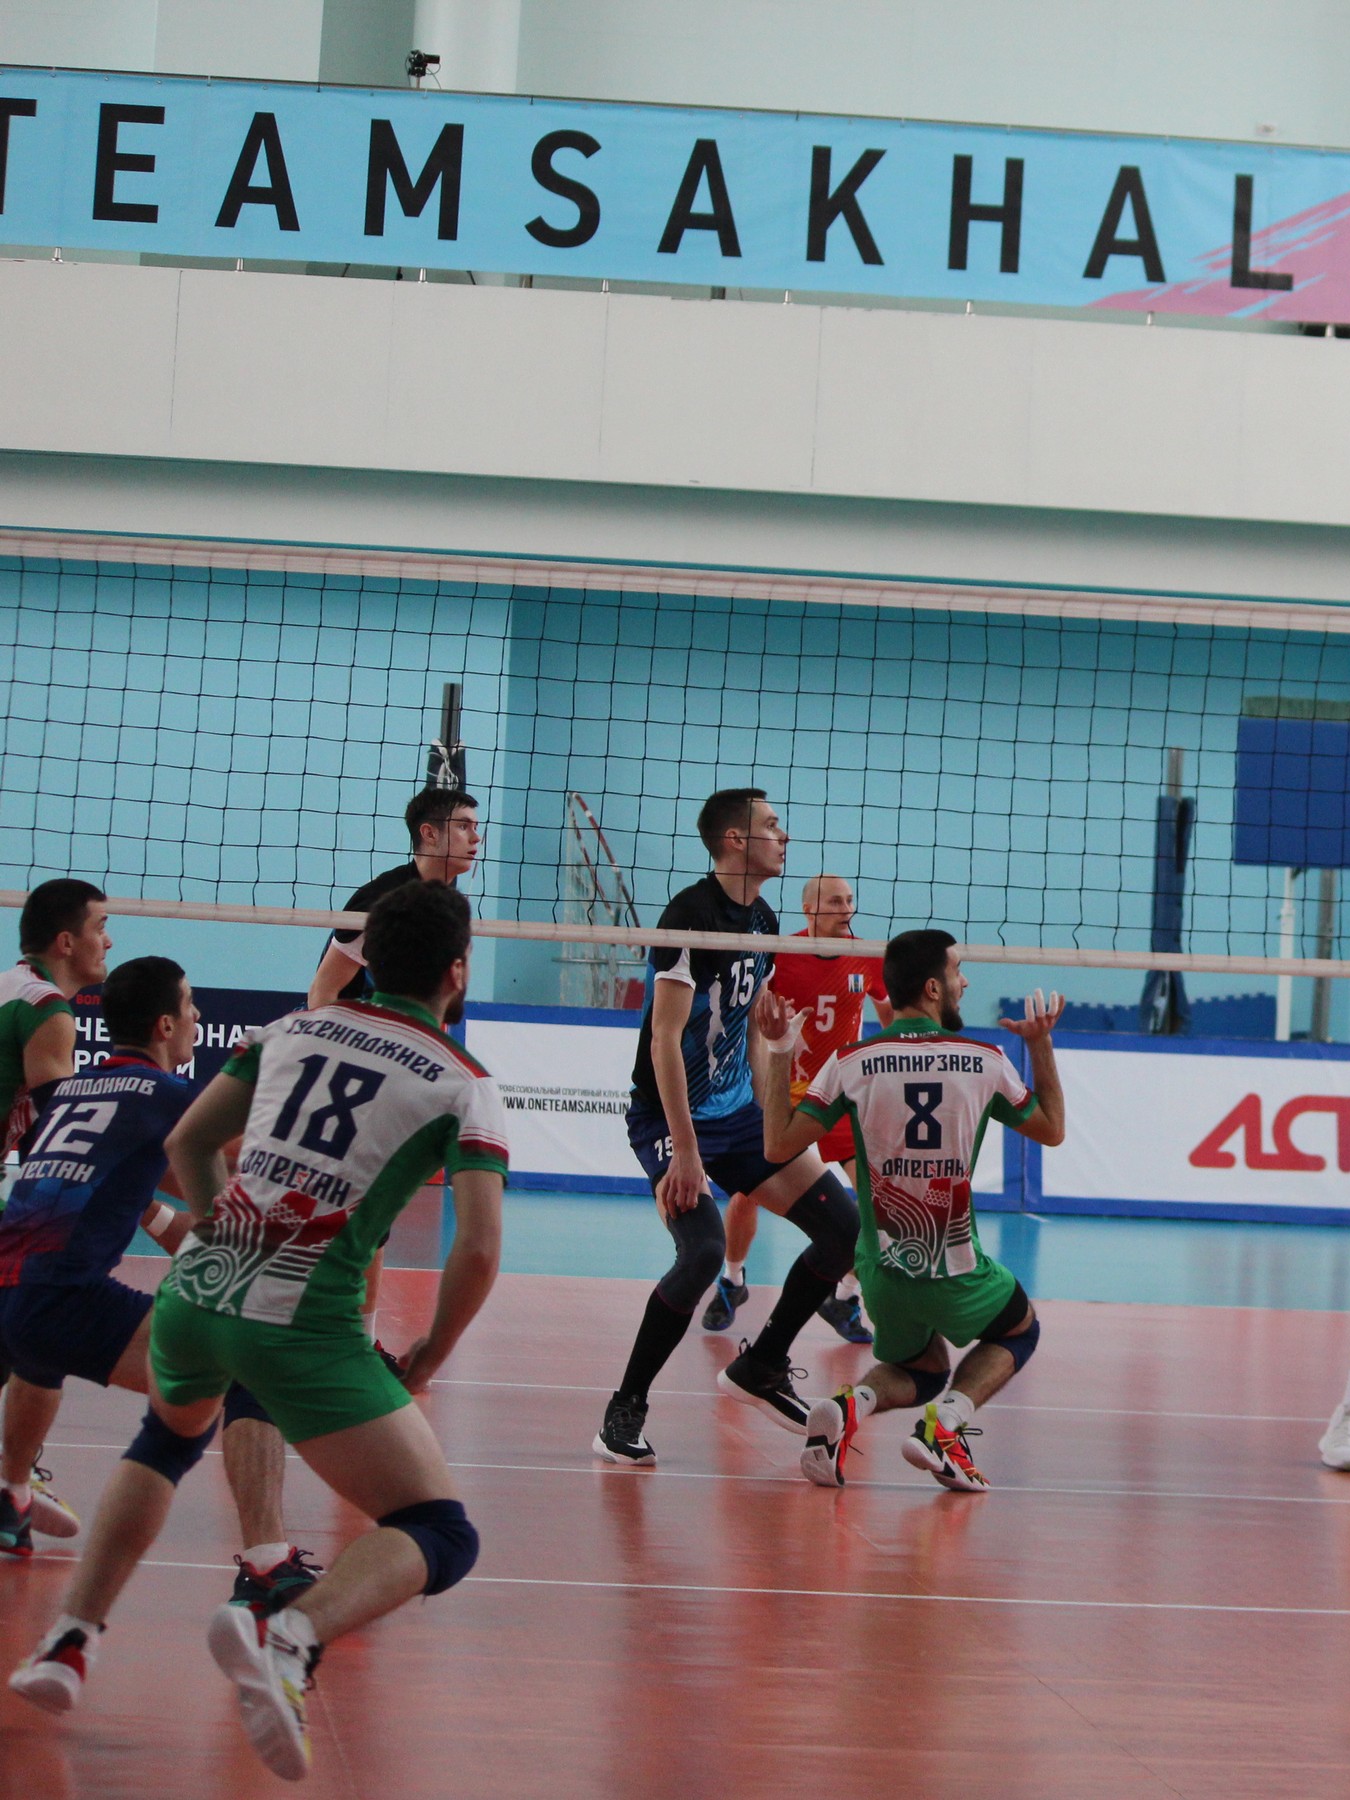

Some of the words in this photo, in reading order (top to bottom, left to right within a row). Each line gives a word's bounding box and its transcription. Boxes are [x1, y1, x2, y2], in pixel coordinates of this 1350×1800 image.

[729, 958, 755, 1008] 15
[815, 995, 837, 1033] 5
[861, 1054, 984, 1076] ИМАМИРЗАЕВ
[29, 1101, 119, 1155] 12
[269, 1053, 387, 1161] 18
[904, 1082, 943, 1150] 8
[241, 1149, 351, 1208] ДАГЕСТАН
[882, 1158, 965, 1179] ДАГЕСТАН
